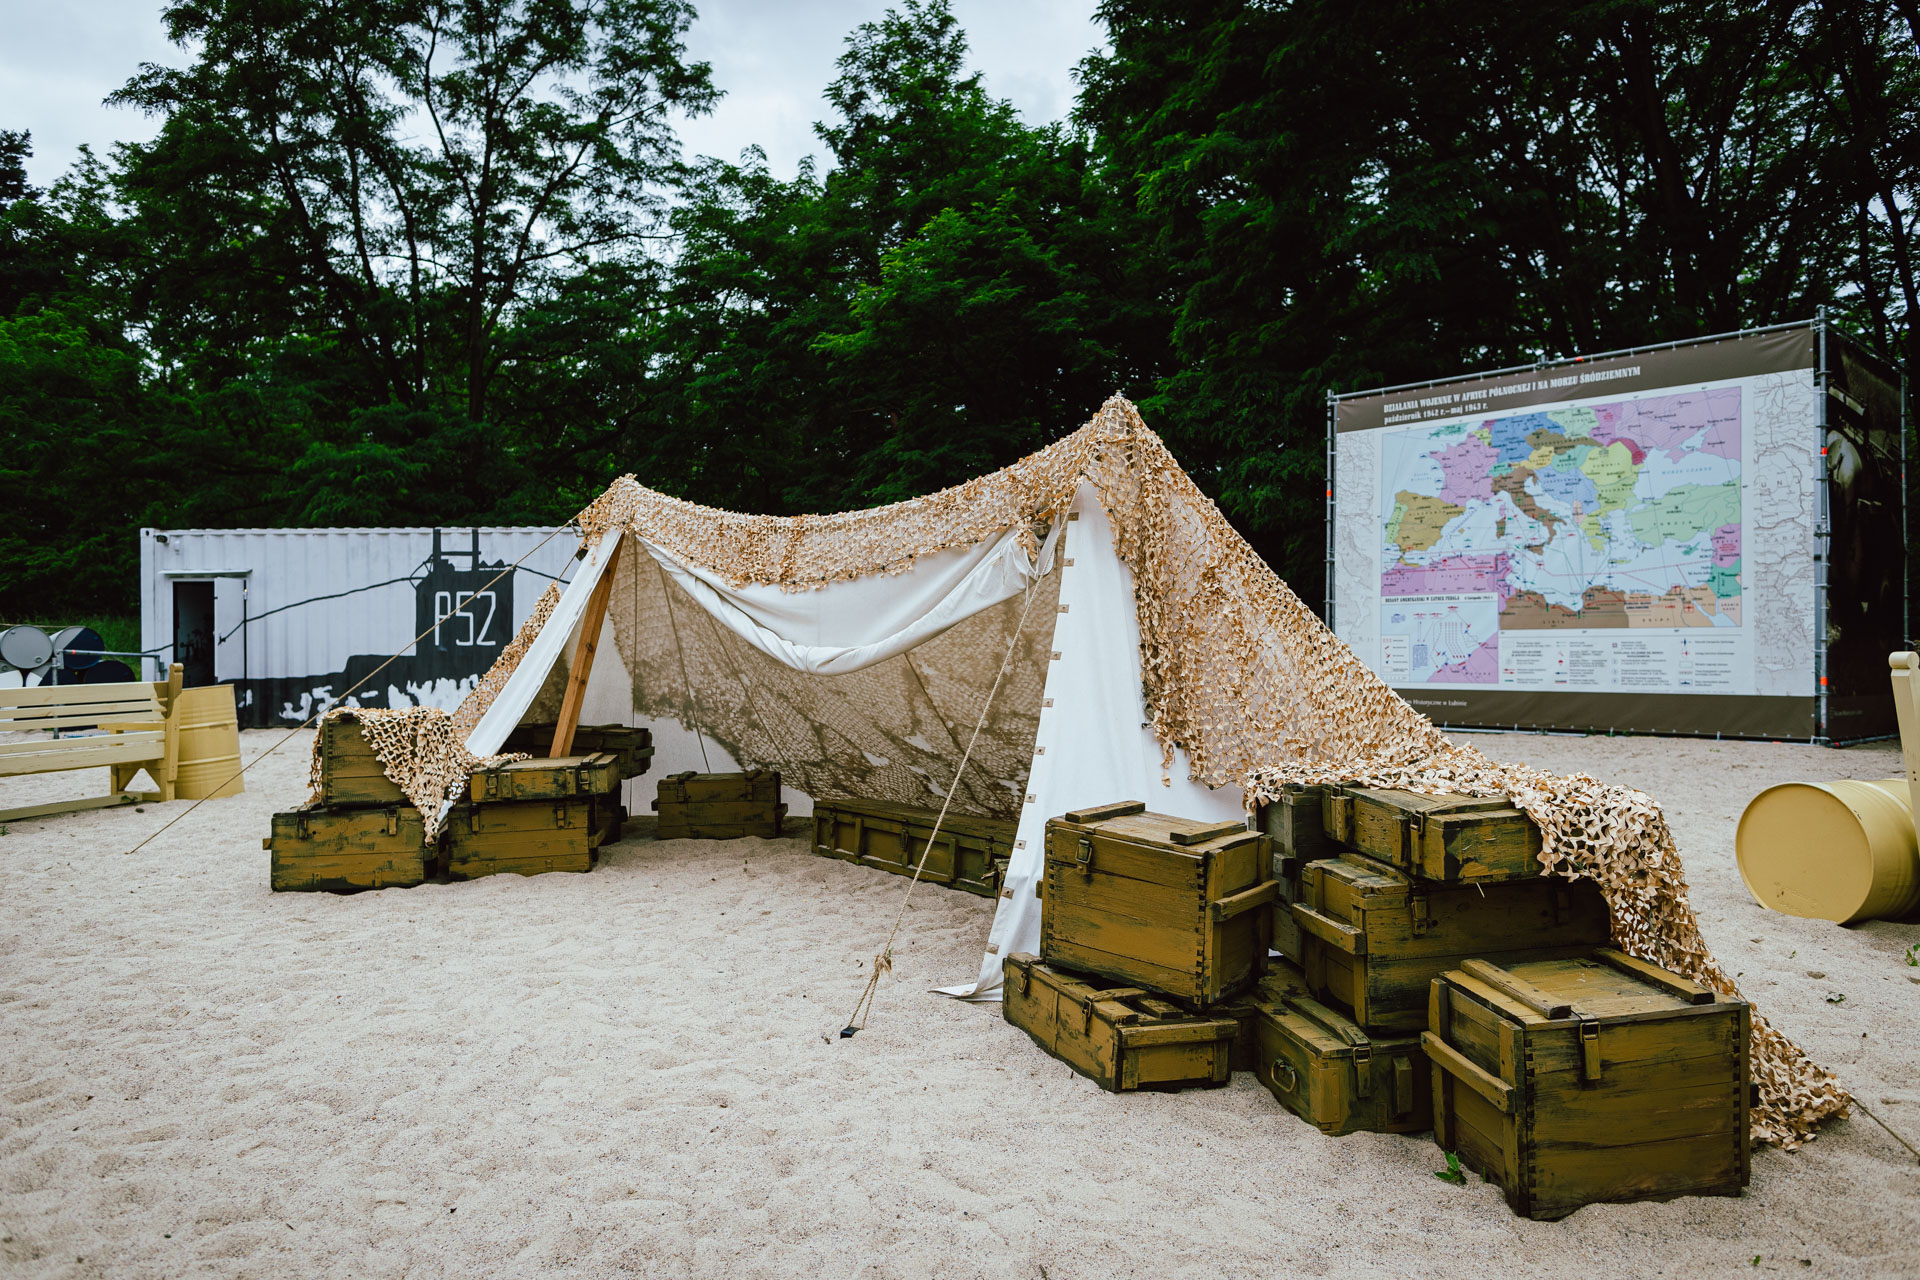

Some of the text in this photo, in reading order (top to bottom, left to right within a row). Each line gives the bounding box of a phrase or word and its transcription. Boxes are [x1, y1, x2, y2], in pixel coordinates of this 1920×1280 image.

[1384, 400, 1418, 413] DZIAŁANIA
[1420, 395, 1452, 407] WOJENNE
[1453, 393, 1460, 403] W
[1462, 389, 1487, 402] AFRYCE
[1488, 382, 1531, 398] PÓŁNOCNEJ
[1537, 379, 1549, 390] NA
[1550, 375, 1579, 388] MORZU
[1579, 366, 1641, 384] ŚRÓDZIEMNYM
[435, 591, 496, 646] P52
